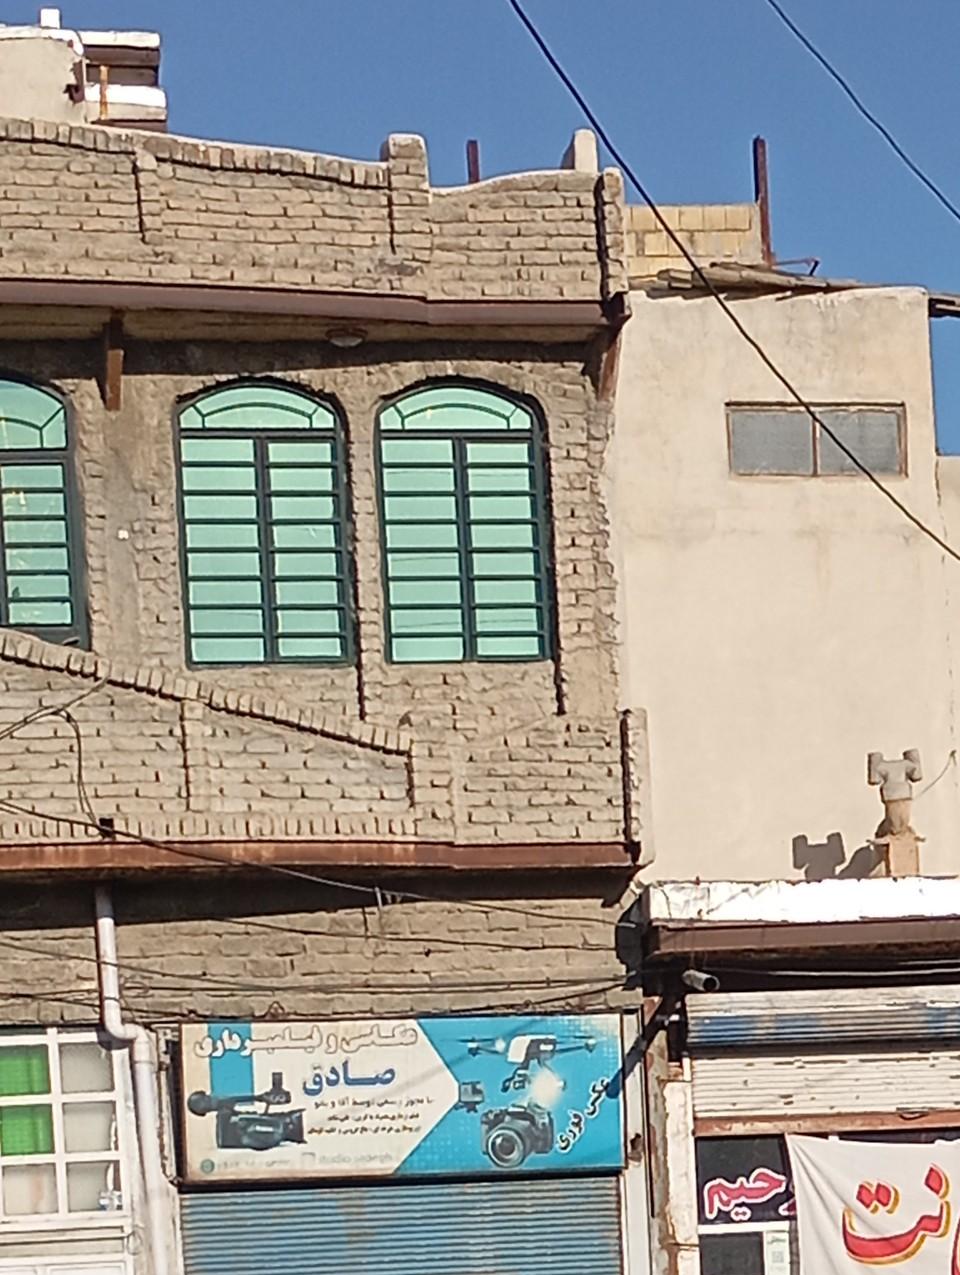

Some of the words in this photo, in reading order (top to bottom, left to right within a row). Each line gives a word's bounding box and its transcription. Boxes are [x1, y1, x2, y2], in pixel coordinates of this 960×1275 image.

[325, 1033, 339, 1055] و
[302, 1060, 396, 1096] صادق
[841, 1162, 952, 1266] نت
